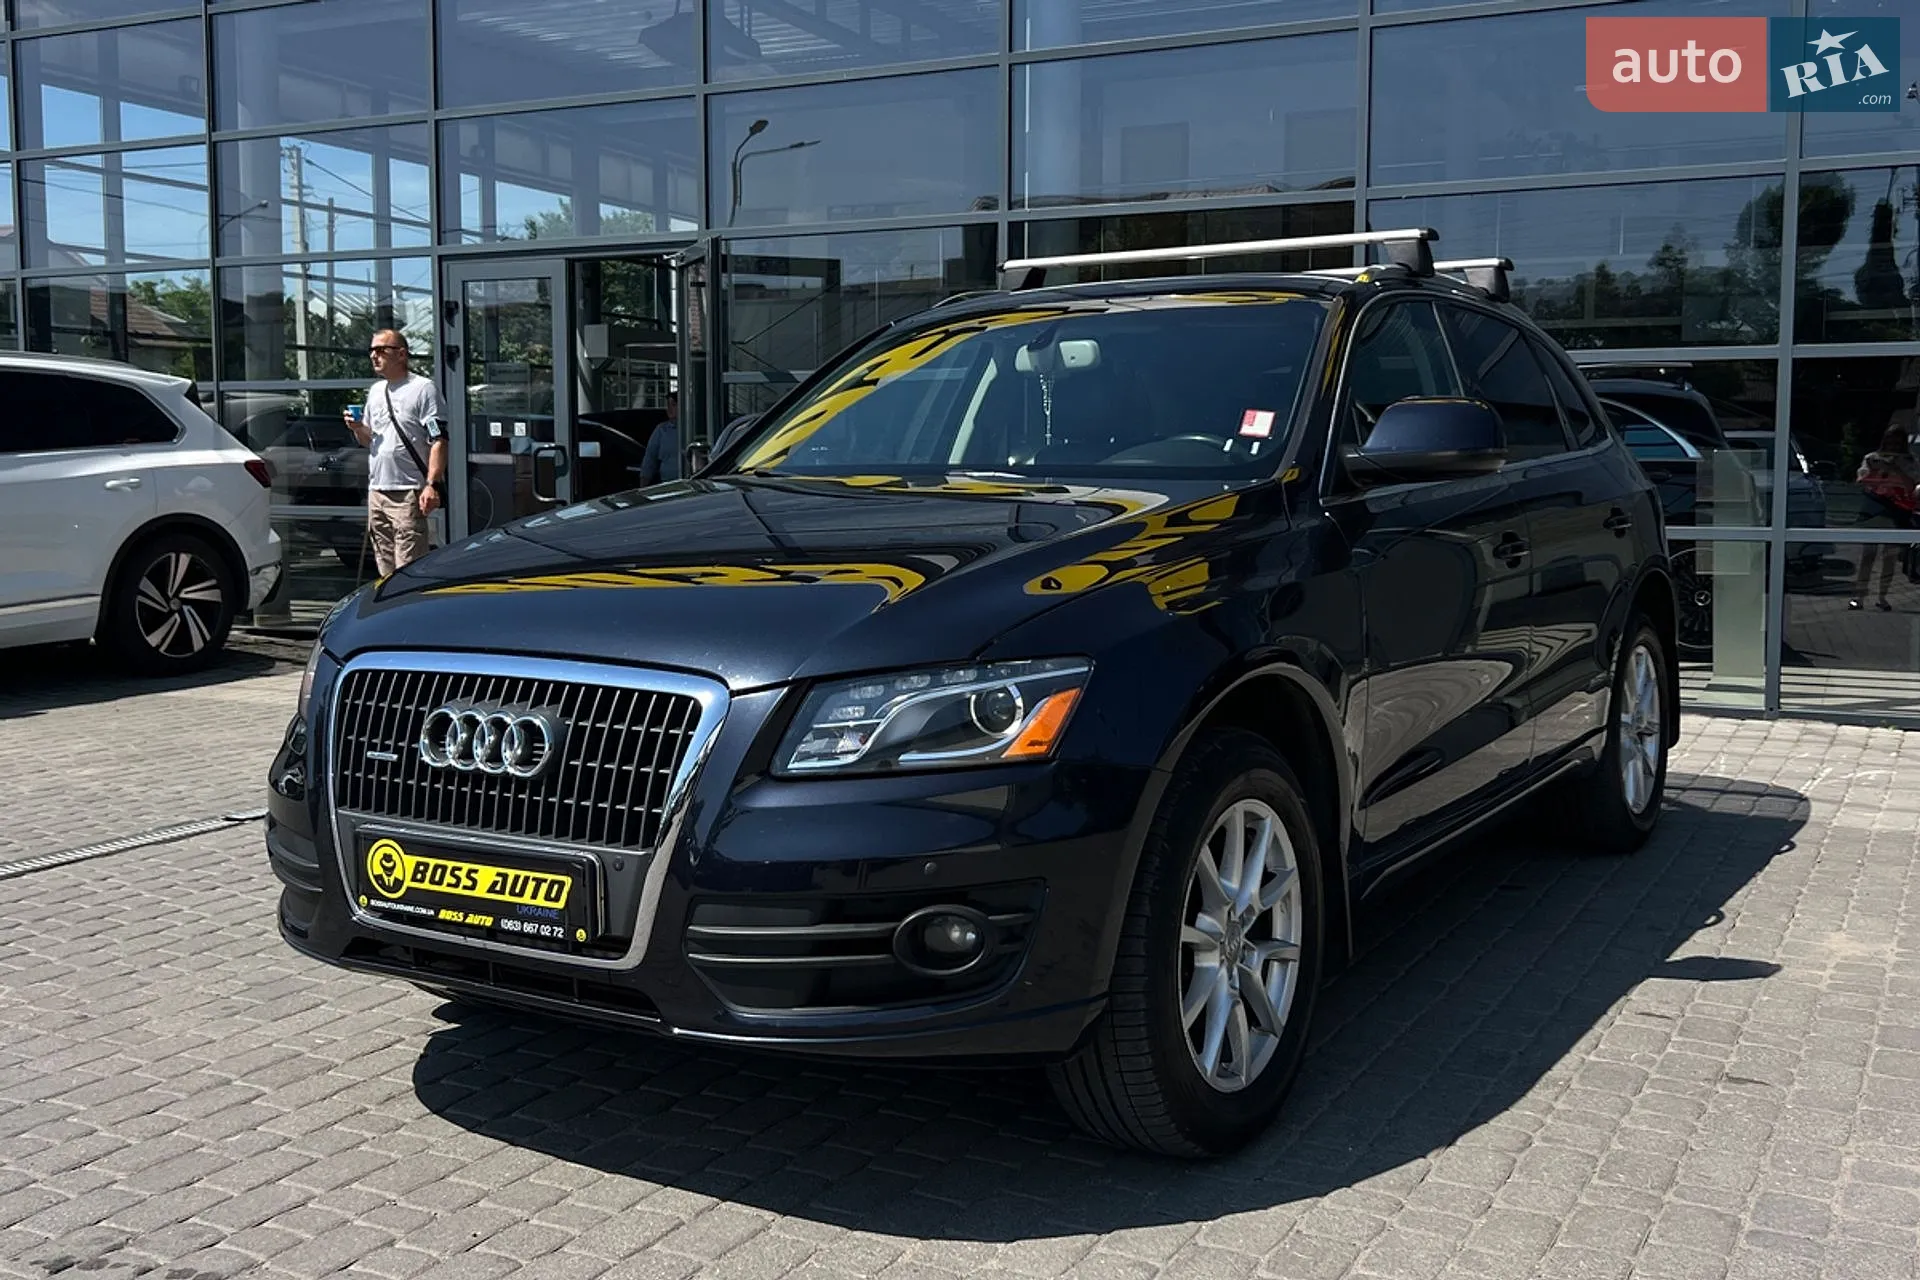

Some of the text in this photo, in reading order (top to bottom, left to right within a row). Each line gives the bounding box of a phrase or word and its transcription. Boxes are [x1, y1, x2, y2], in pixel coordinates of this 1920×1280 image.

[411, 861, 567, 903] BOSS AUTO
[438, 909, 494, 927] BOSS AUTO
[516, 904, 559, 919] UKRAINE
[540, 924, 551, 936] 02
[552, 926, 564, 938] 72
